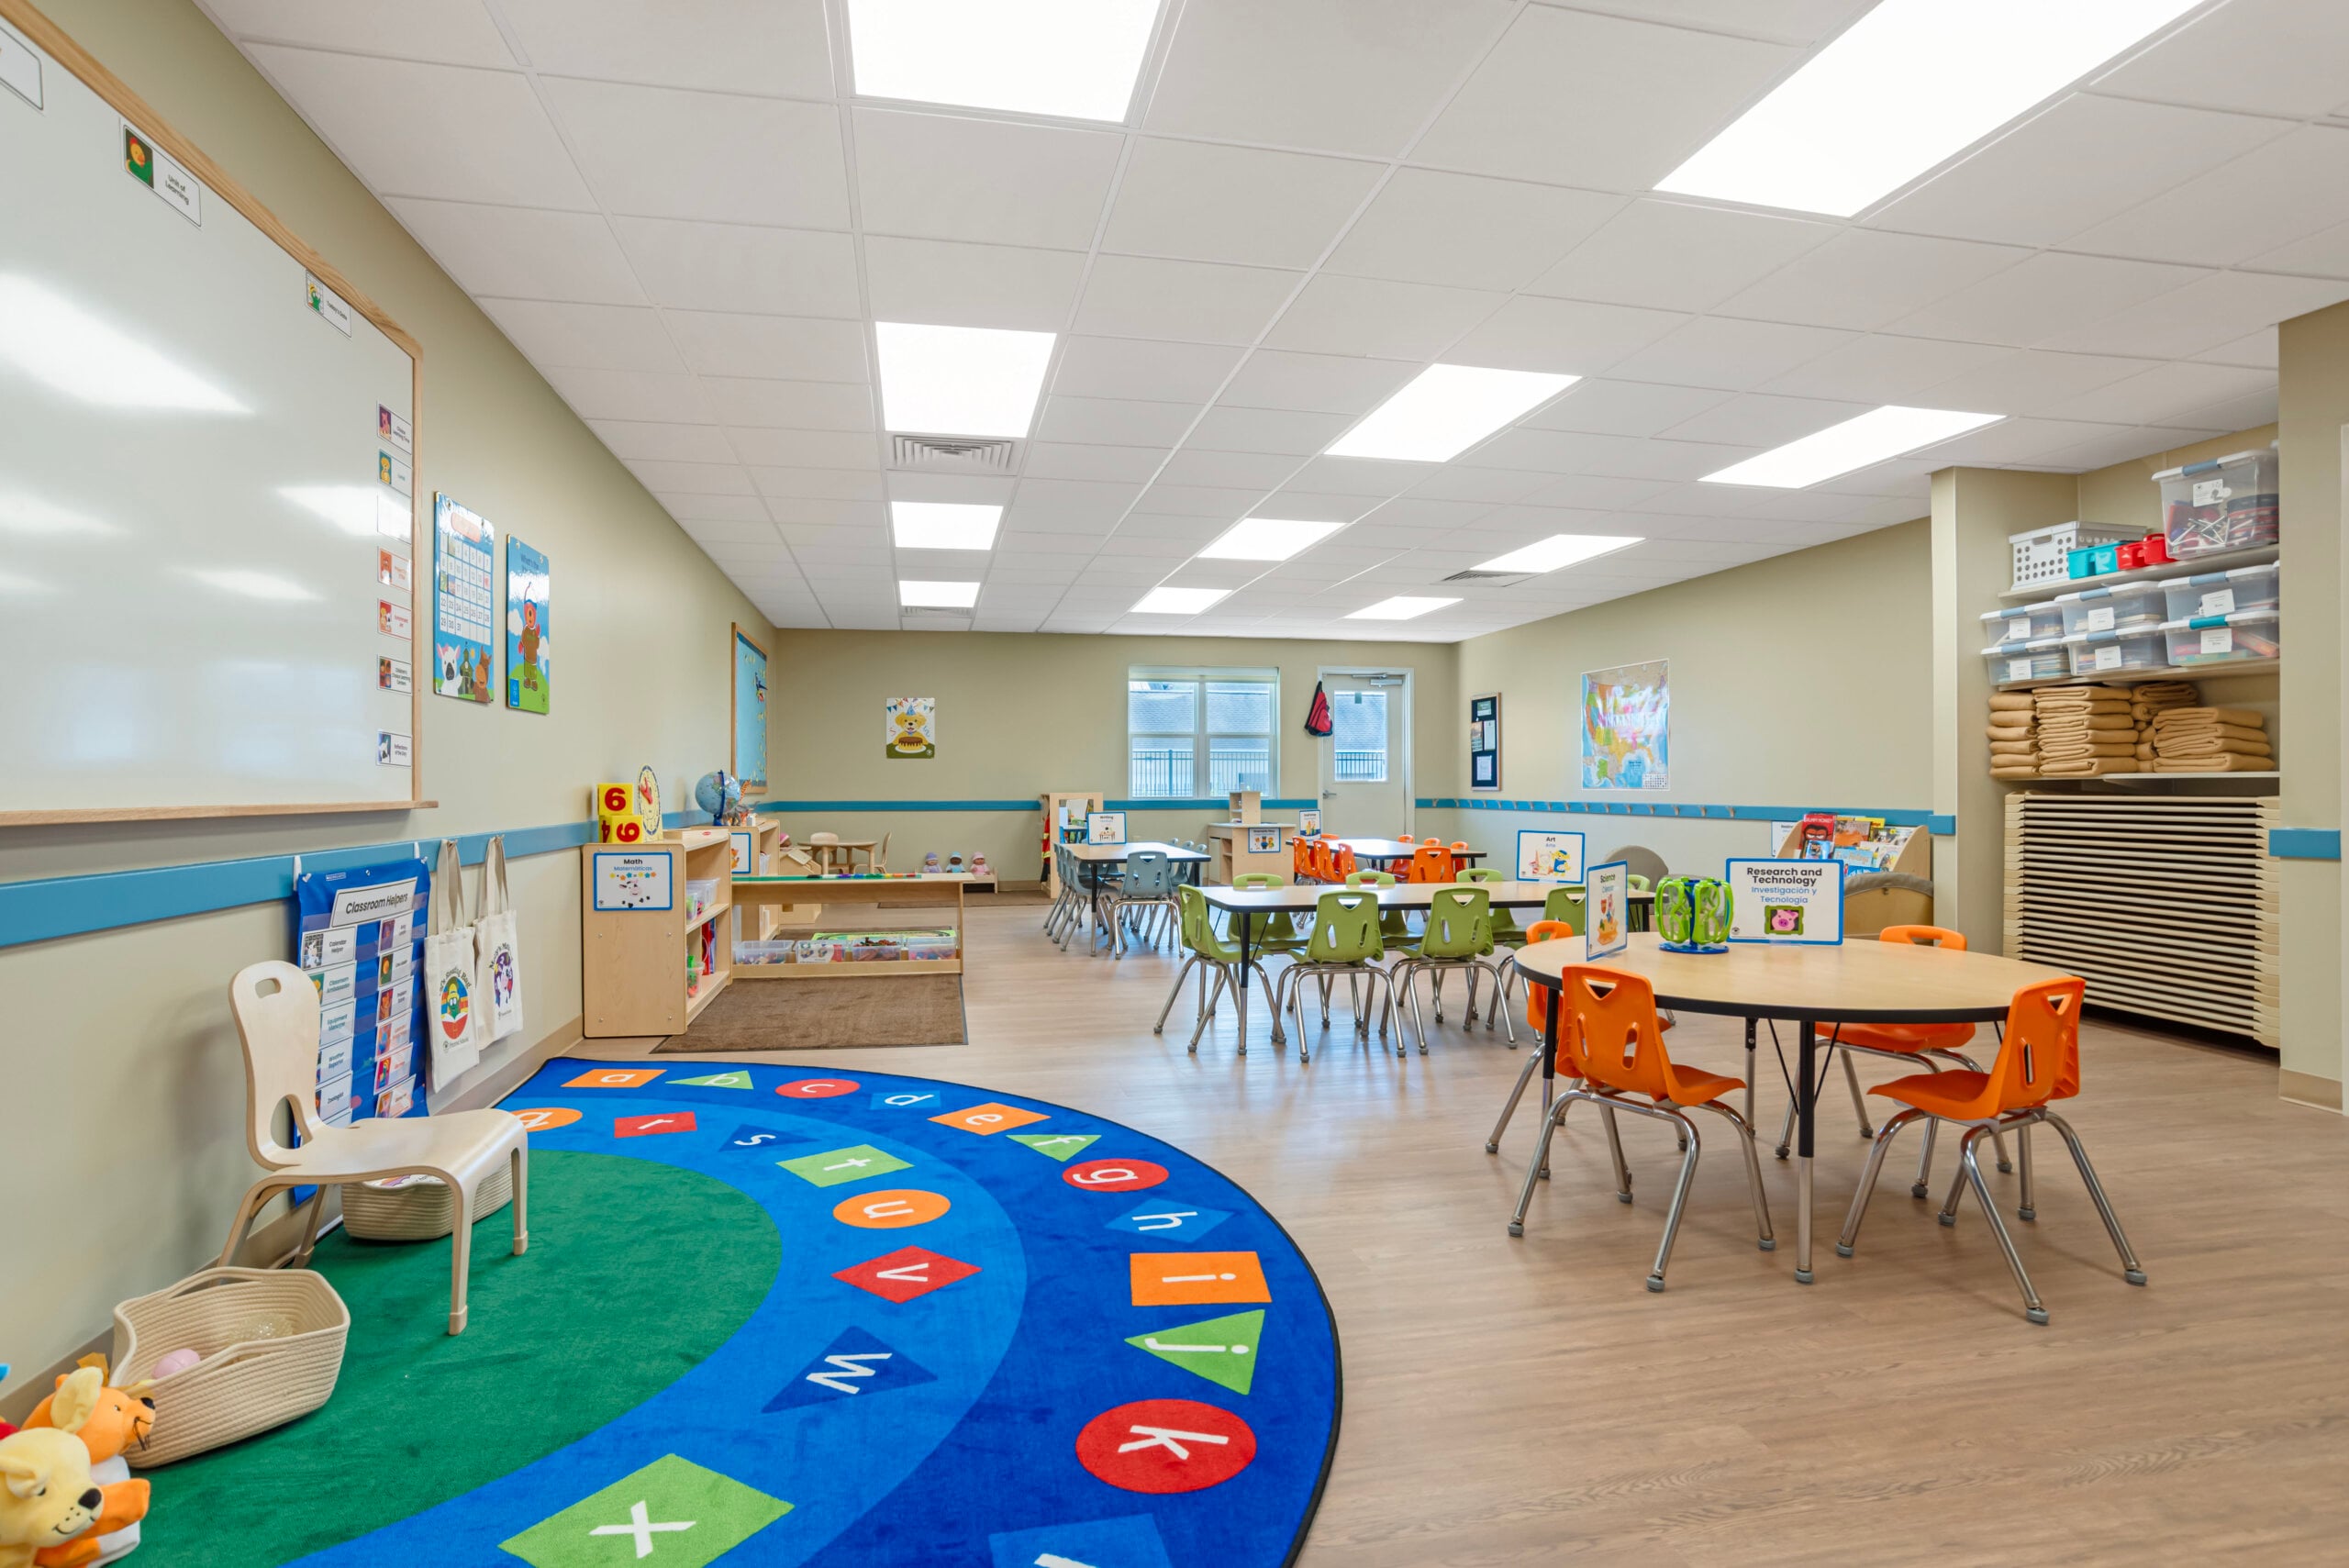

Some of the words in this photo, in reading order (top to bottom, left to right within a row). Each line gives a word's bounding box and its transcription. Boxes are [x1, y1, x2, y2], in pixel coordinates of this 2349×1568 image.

[168, 174, 180, 186] Unit
[165, 180, 189, 206] Learning
[1746, 867, 1798, 876] Research
[1800, 868, 1822, 876] and
[1600, 873, 1616, 883] Science
[1752, 875, 1817, 887] Technology
[1751, 886, 1810, 895] Investigación
[345, 897, 385, 915] Classroom
[385, 893, 408, 908] Helpers
[1760, 895, 1809, 905] Tecnología
[329, 939, 347, 948] Calendar
[600, 1073, 637, 1084] a
[704, 1073, 740, 1086] b
[801, 1084, 836, 1093] c
[884, 1093, 935, 1106] d
[637, 1118, 675, 1130] r
[965, 1113, 1004, 1127] e
[734, 1133, 777, 1146] s
[1032, 1136, 1087, 1147] f
[822, 1157, 872, 1172] t
[1072, 1167, 1139, 1184] g
[863, 1199, 915, 1219] u
[1131, 1210, 1198, 1231] h
[876, 1262, 930, 1283] v
[1162, 1273, 1237, 1284] i
[1144, 1337, 1250, 1354] j
